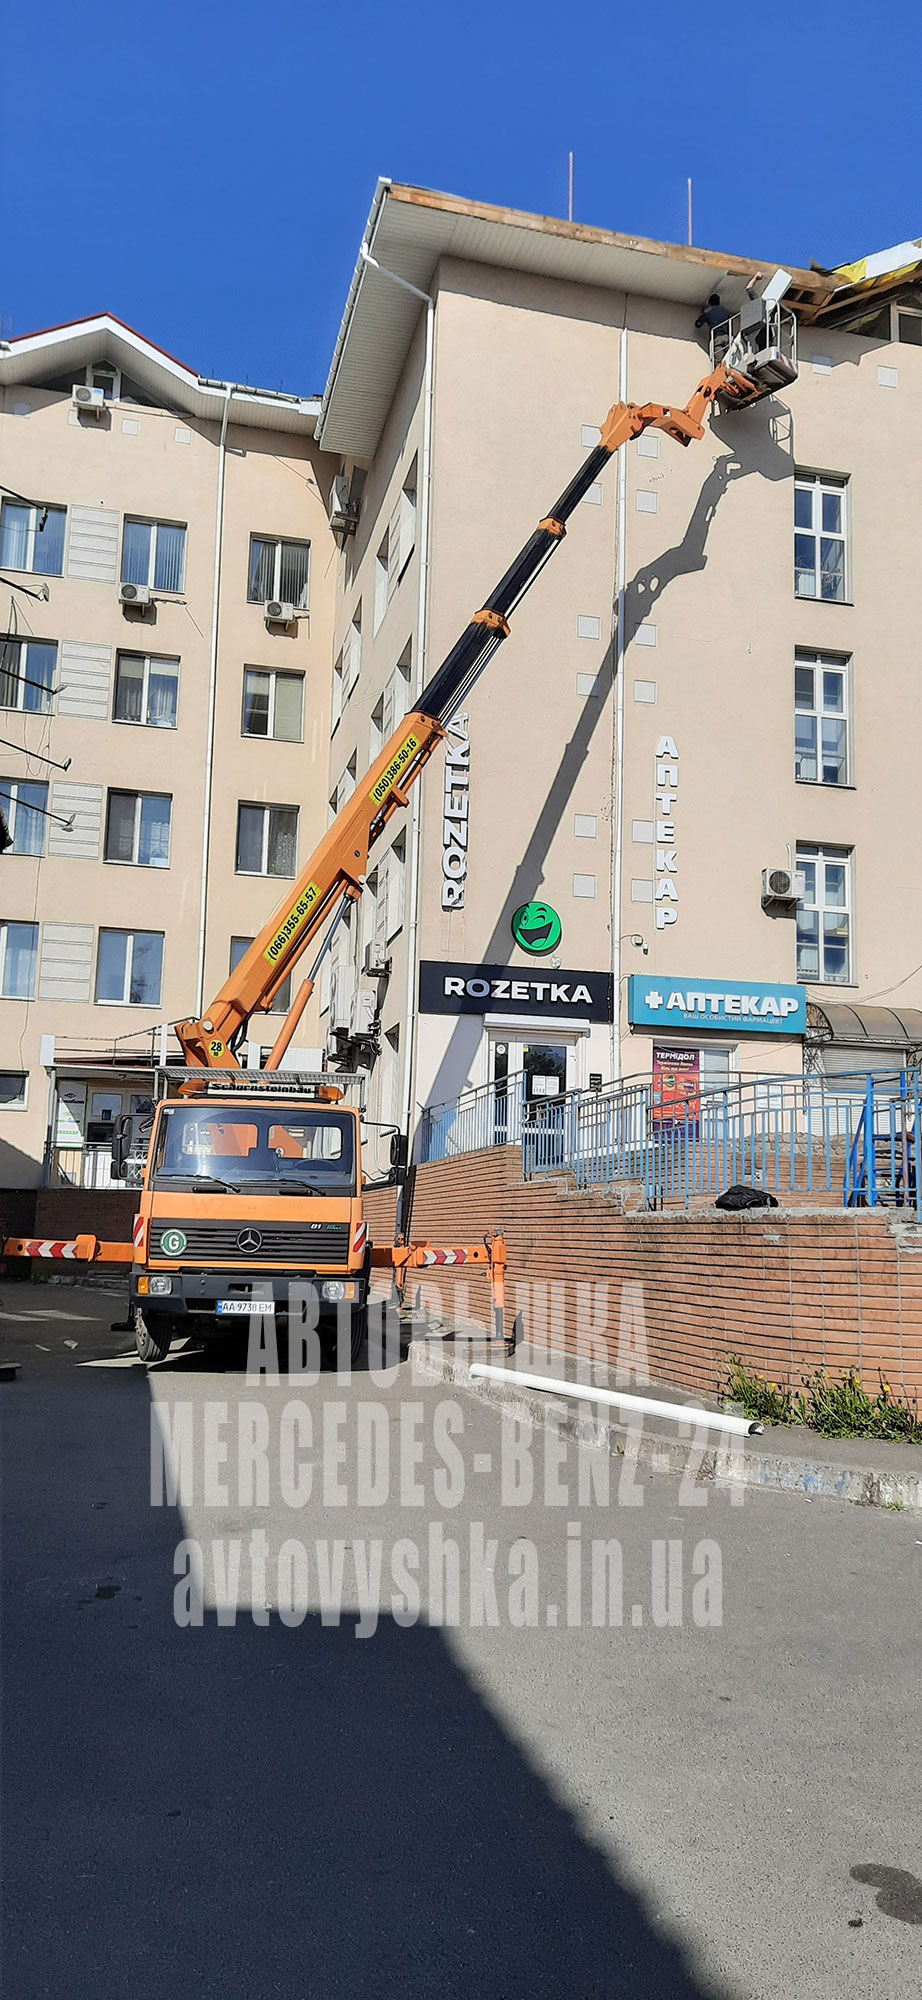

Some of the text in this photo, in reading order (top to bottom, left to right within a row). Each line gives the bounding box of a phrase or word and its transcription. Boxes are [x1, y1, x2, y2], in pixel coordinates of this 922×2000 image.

[372, 738, 417, 802] (050)386-50-16
[441, 711, 470, 911] ROZETKA
[654, 735, 679, 930] АПТЕКАР
[267, 886, 317, 961] (066)355-65-57
[444, 976, 593, 1004] ROZETKA
[666, 991, 799, 1017] АПТЕКАР
[210, 1041, 222, 1052] 28
[656, 1051, 695, 1061] ТЕРМІДОЛ
[168, 1234, 180, 1251] G
[222, 1302, 272, 1313] AA 9738 EM
